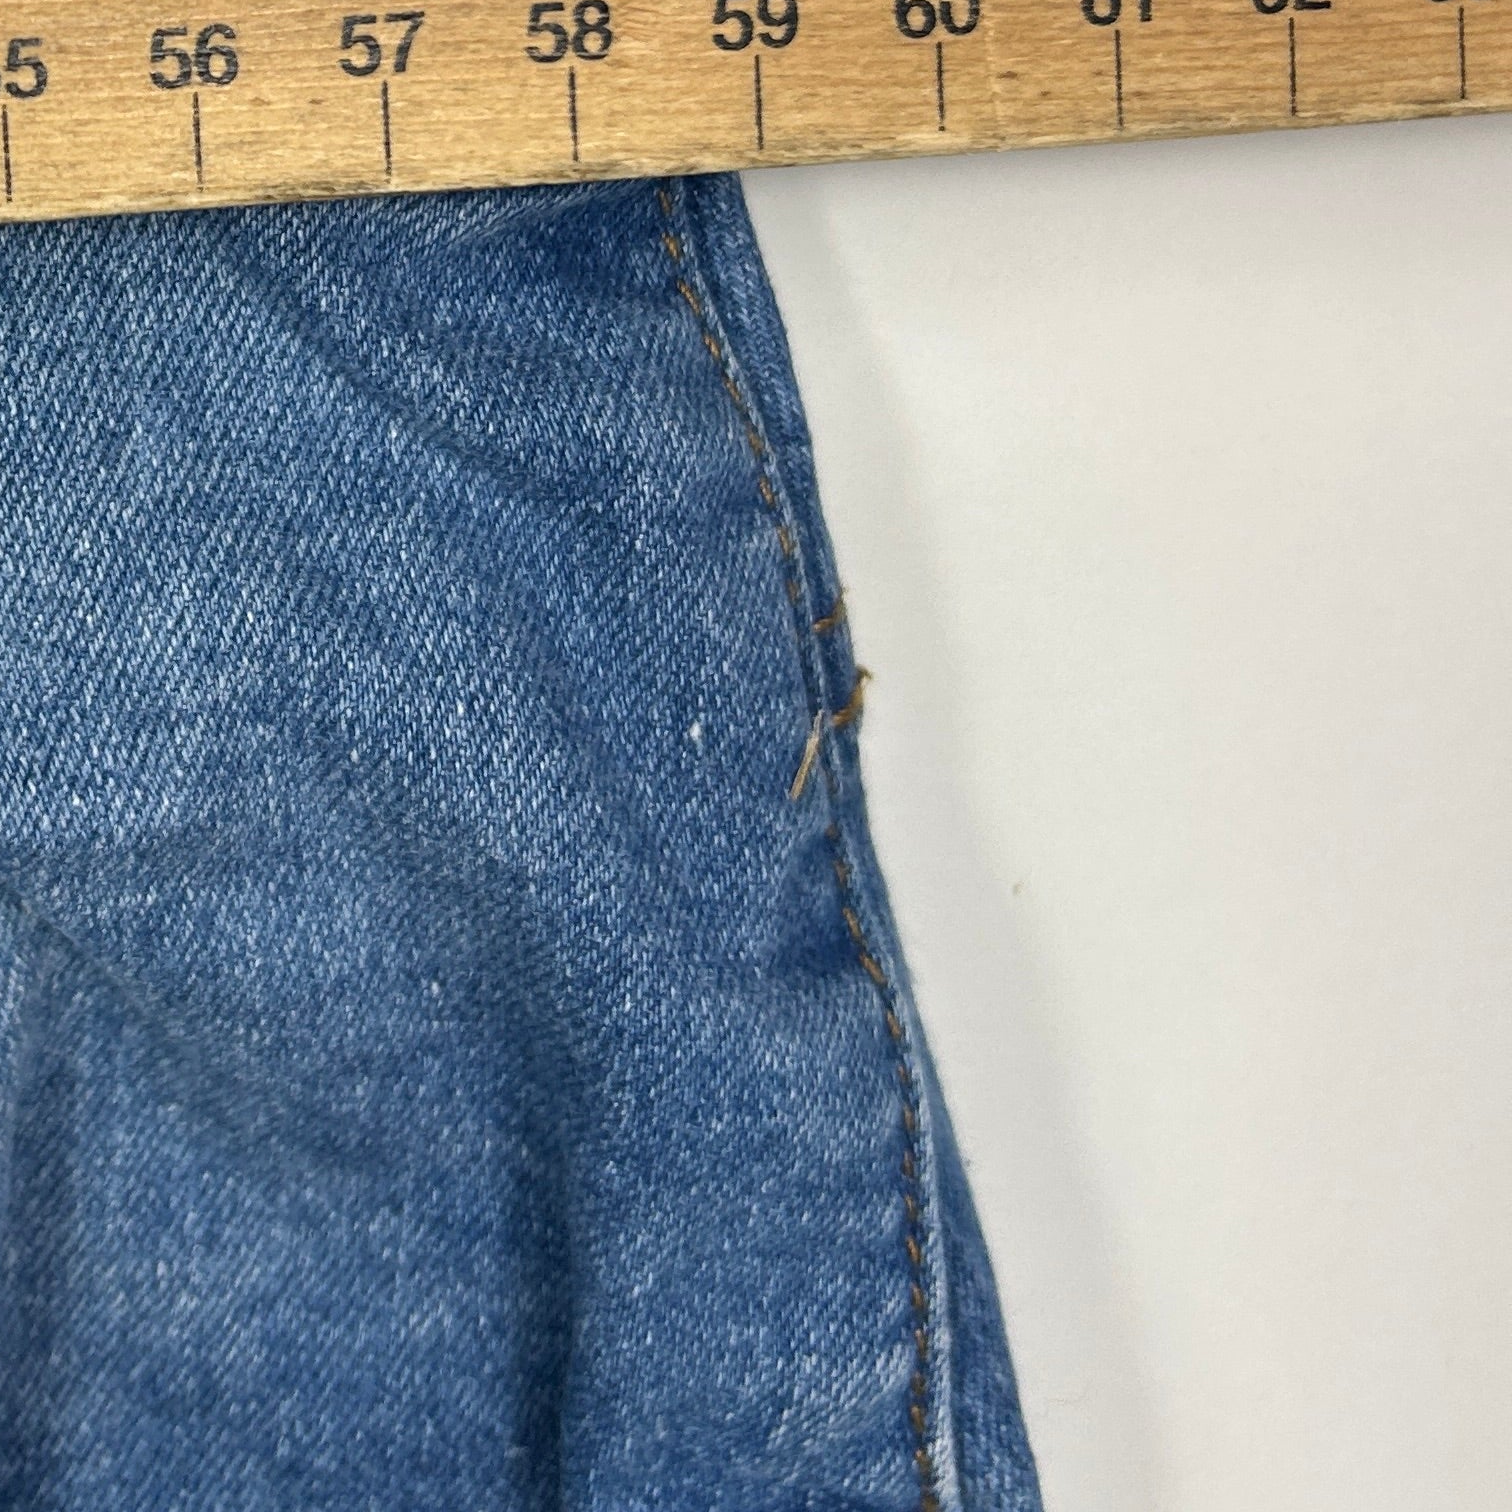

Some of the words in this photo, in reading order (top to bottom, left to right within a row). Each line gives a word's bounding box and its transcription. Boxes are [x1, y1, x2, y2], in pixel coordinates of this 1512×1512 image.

[150, 23, 240, 90] 56
[338, 11, 425, 77] 57
[523, 0, 618, 63] 58
